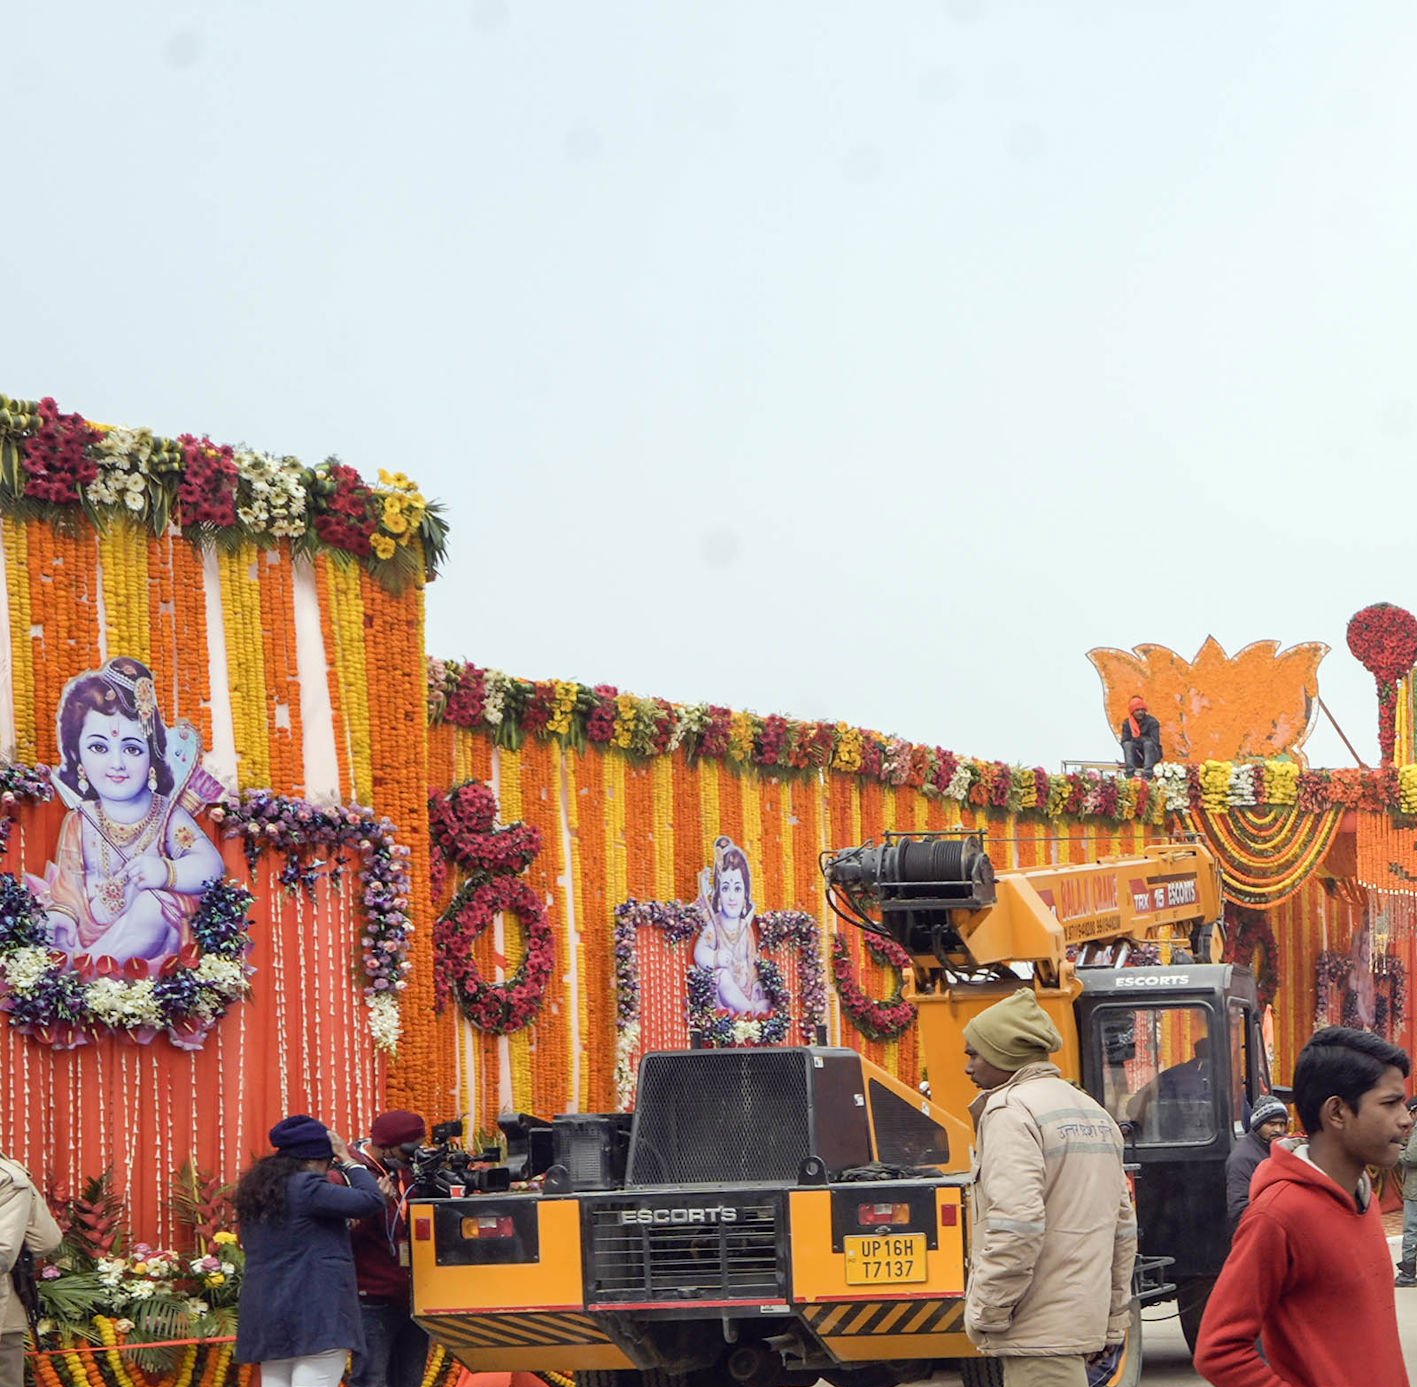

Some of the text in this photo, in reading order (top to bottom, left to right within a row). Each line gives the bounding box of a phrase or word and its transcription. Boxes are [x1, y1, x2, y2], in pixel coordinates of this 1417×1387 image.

[1167, 880, 1196, 907] ESCORTS
[1115, 975, 1190, 987] ESCORTS
[621, 1207, 737, 1224] ESCORTS
[862, 1259, 914, 1279] T7137
